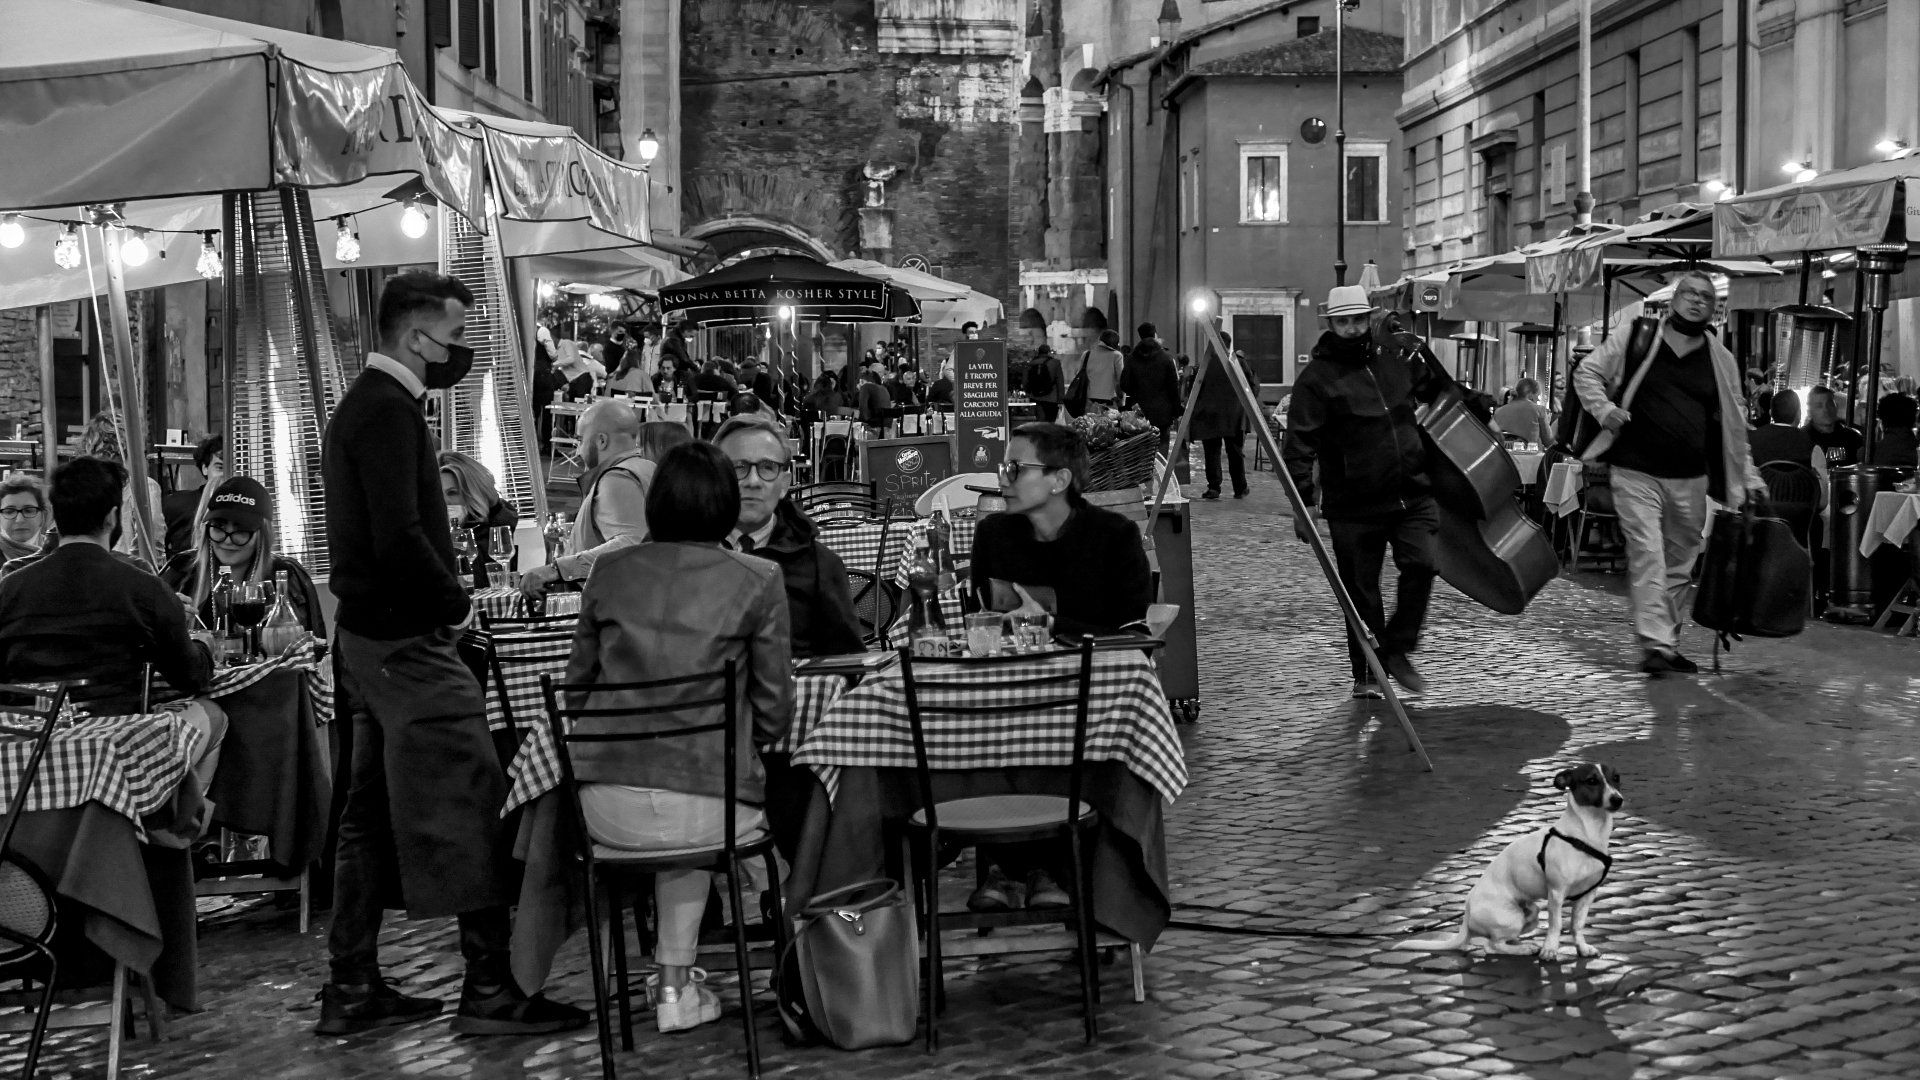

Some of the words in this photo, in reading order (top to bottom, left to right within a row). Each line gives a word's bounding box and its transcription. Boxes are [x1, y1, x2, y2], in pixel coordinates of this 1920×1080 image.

[664, 291, 719, 306] NONNA
[725, 288, 766, 300] BETTA
[776, 288, 834, 299] KOSHER
[839, 288, 877, 300] STYLE
[970, 372, 998, 380] TROPPO
[960, 410, 976, 418] ALLA
[215, 493, 256, 506] adidas
